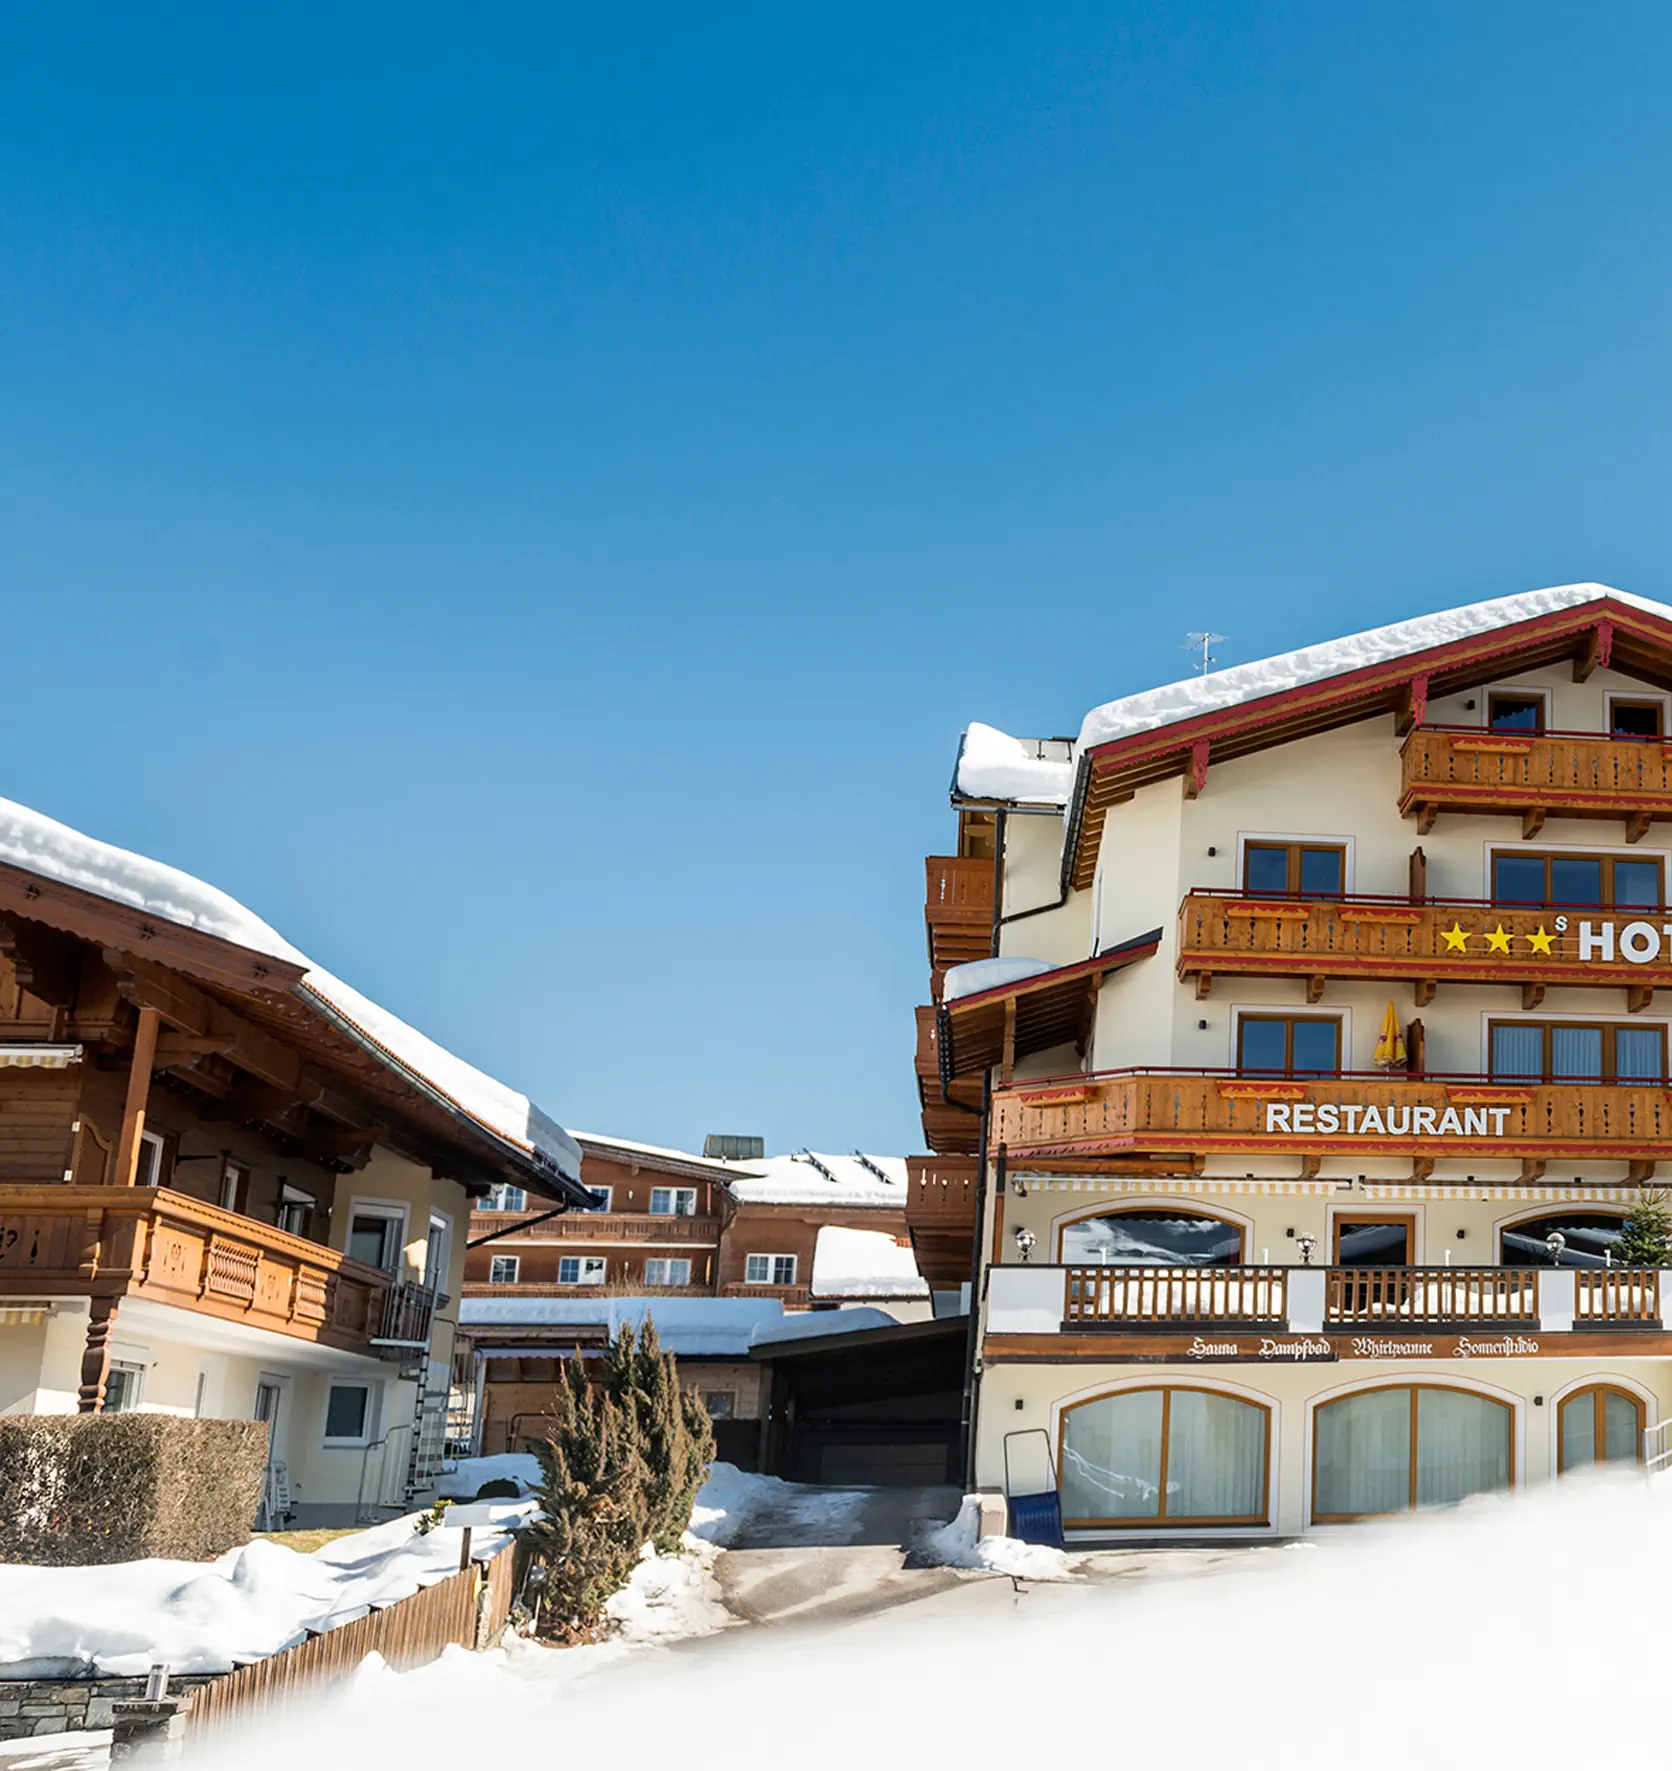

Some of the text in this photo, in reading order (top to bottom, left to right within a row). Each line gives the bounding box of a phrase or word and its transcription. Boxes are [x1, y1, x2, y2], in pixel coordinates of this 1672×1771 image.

[1554, 915, 1568, 931] S
[1266, 1103, 1511, 1136] RESTAURANT
[1186, 1336, 1539, 1361] Sauna Dampfbad Whirlwanne Sonnenstudio
